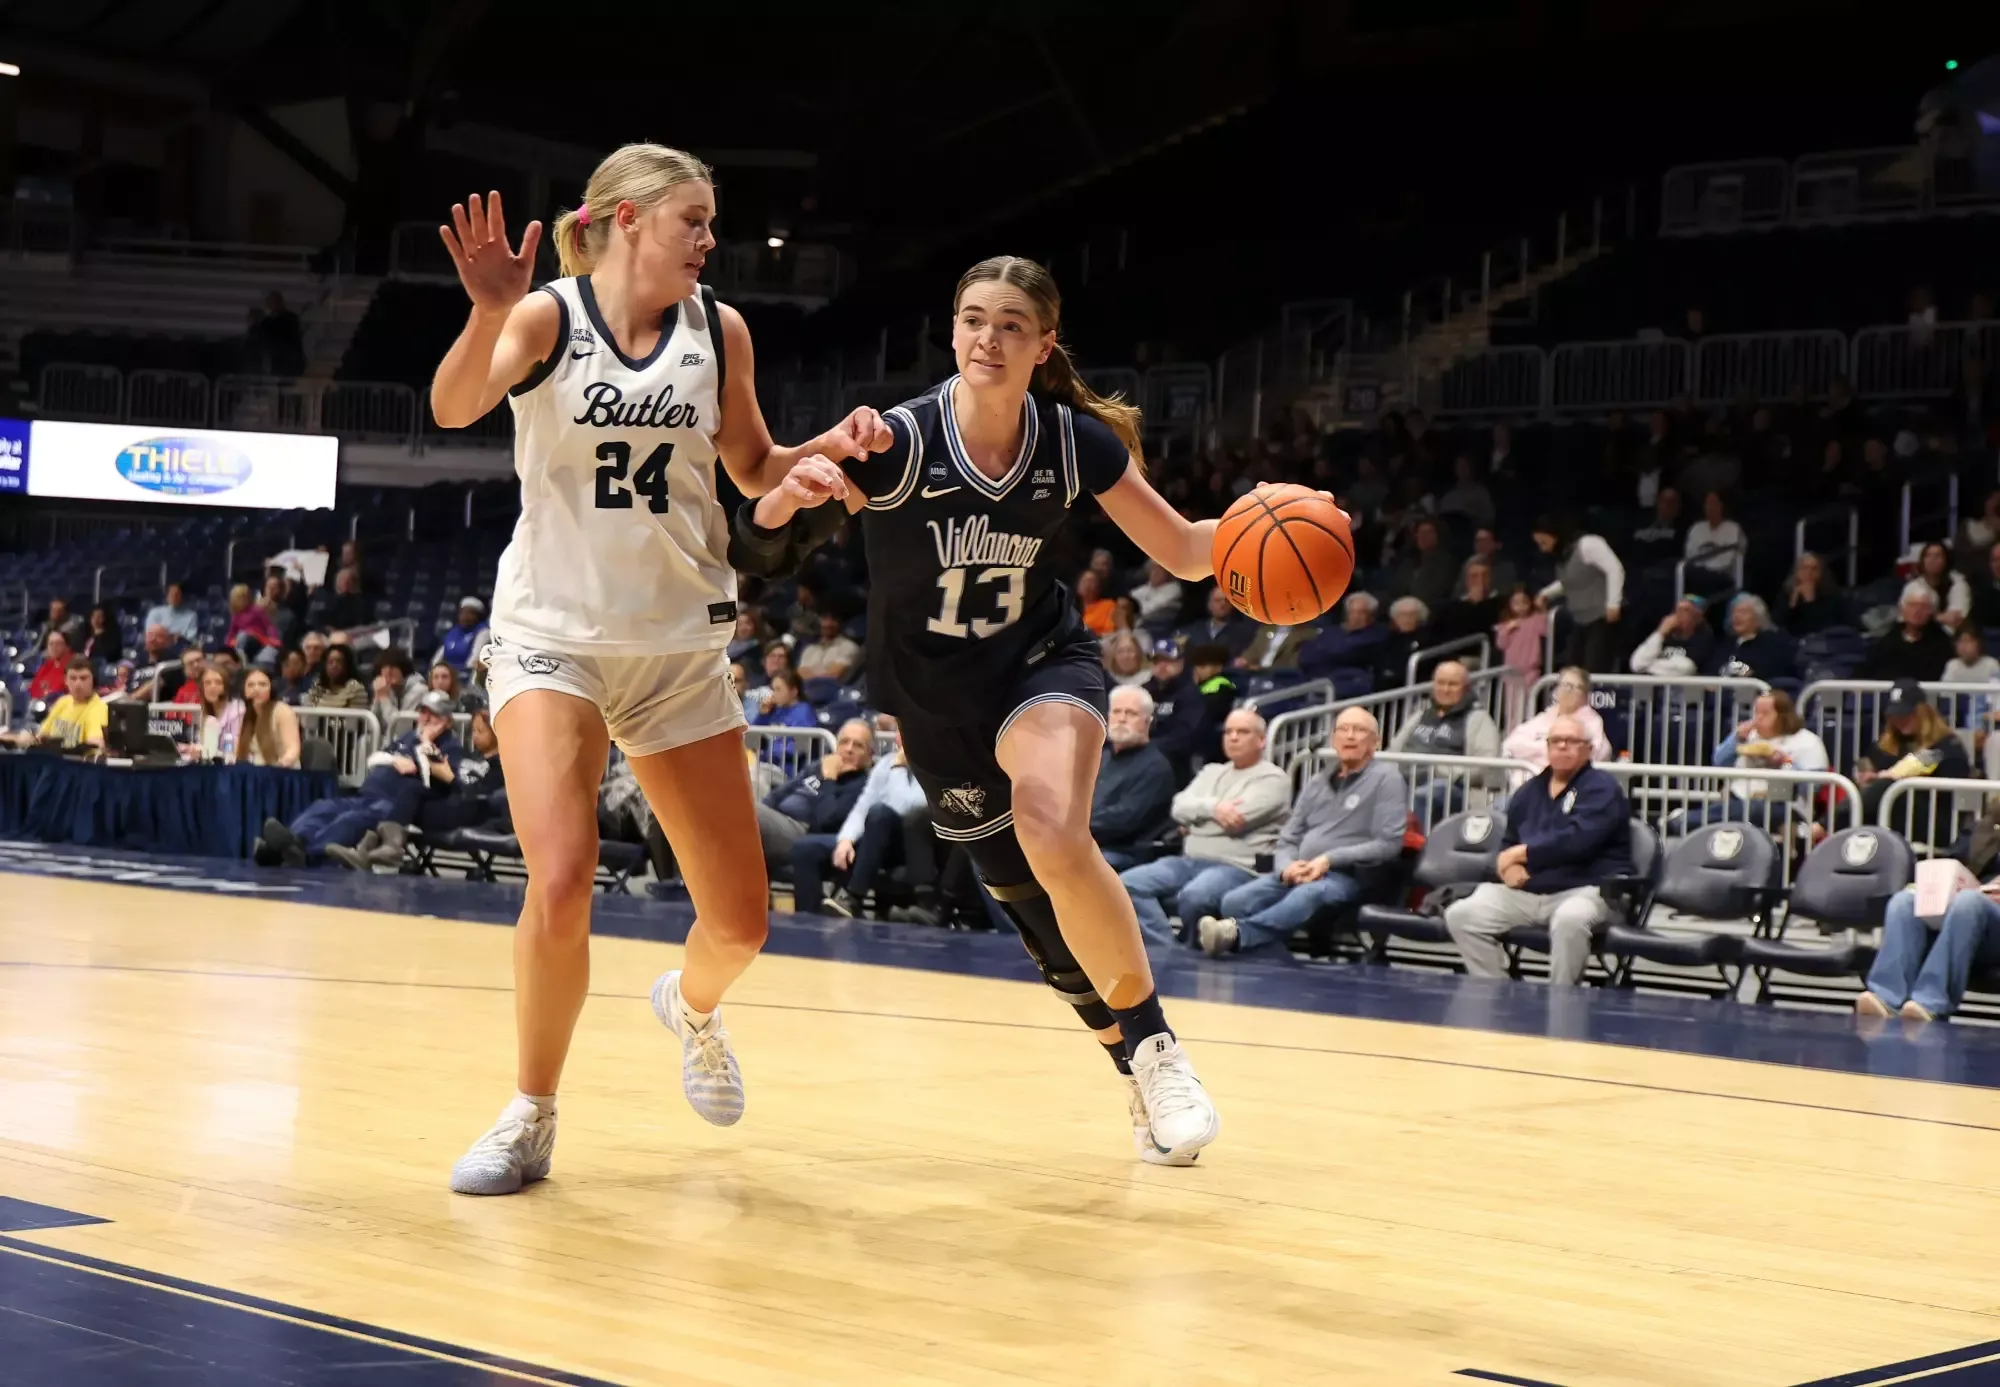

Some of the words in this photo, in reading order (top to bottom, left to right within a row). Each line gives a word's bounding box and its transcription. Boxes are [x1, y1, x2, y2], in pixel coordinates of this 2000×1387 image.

[570, 335, 596, 346] CHANG
[573, 381, 699, 428] Butler
[595, 441, 675, 514] 24
[1031, 476, 1056, 484] CHANG
[1034, 469, 1044, 477] BE
[926, 513, 1044, 568] Villanova
[926, 567, 1027, 640] 13
